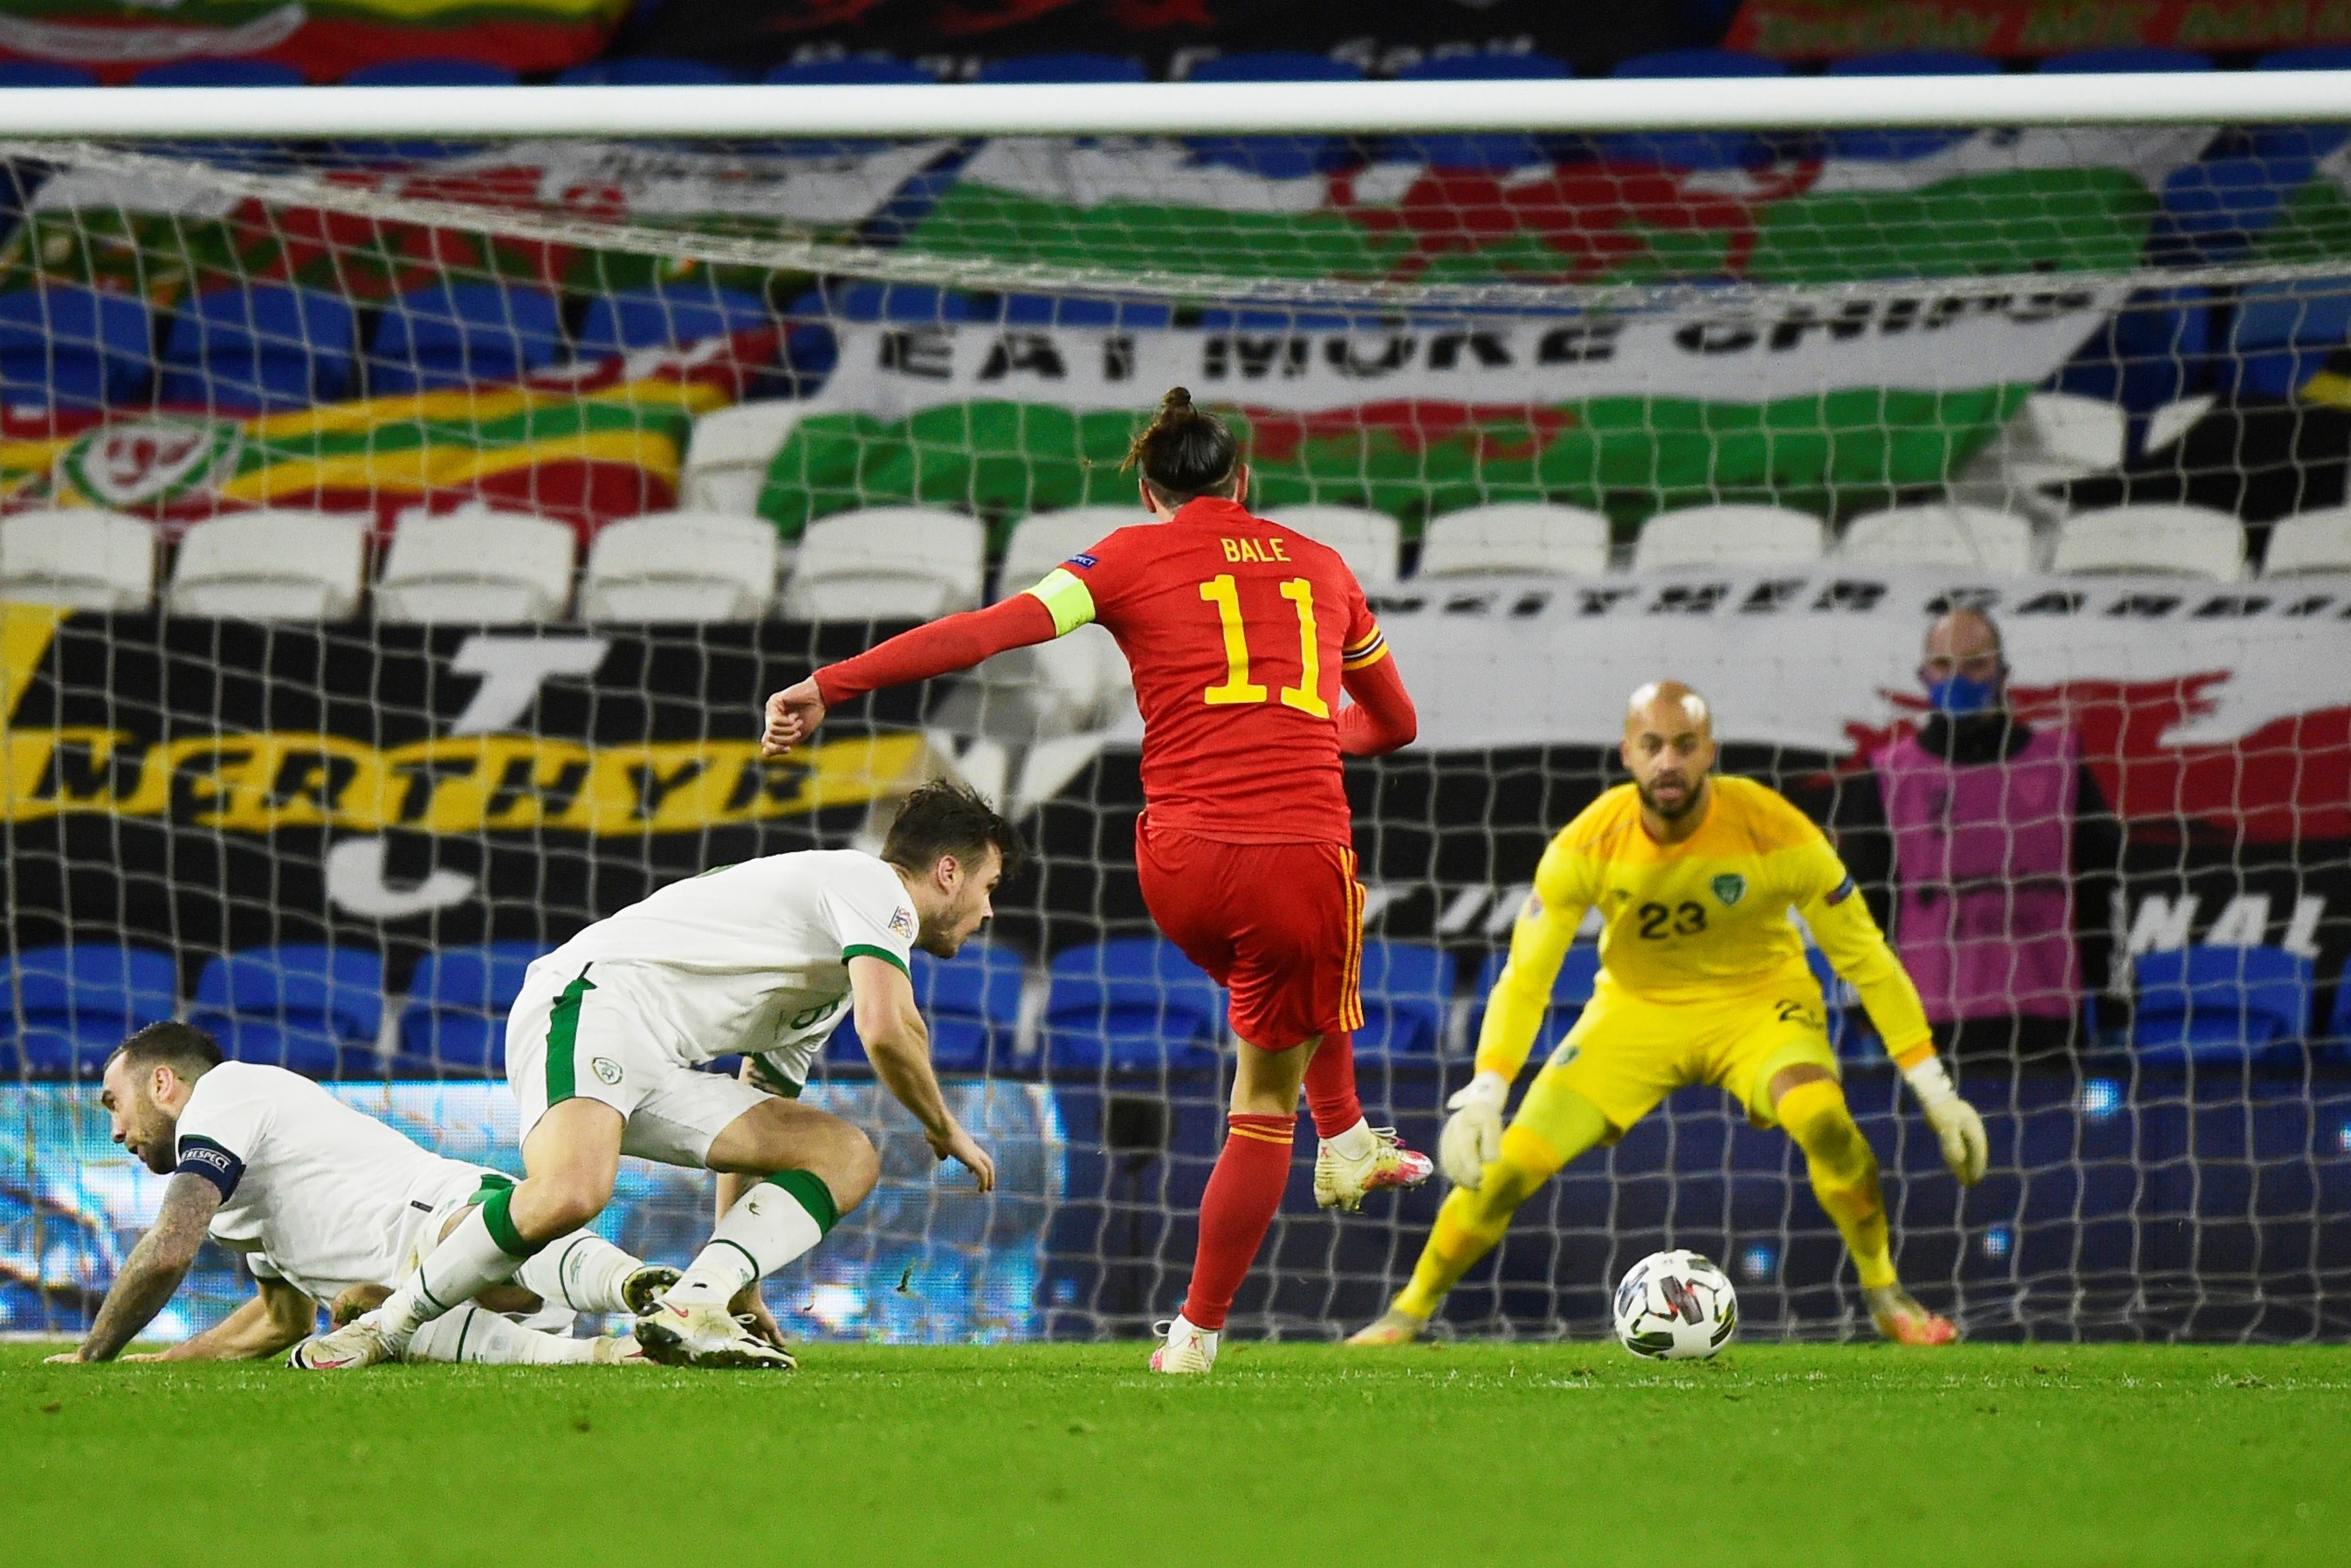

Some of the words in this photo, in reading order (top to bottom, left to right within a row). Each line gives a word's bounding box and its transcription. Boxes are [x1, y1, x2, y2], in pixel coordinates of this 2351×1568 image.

[1220, 538, 1291, 562] BALE
[1199, 574, 1330, 719] 11
[449, 635, 610, 735] T
[31, 742, 817, 823] MERTHYR
[1638, 901, 1708, 940] 23
[186, 1150, 230, 1169] RESPECT
